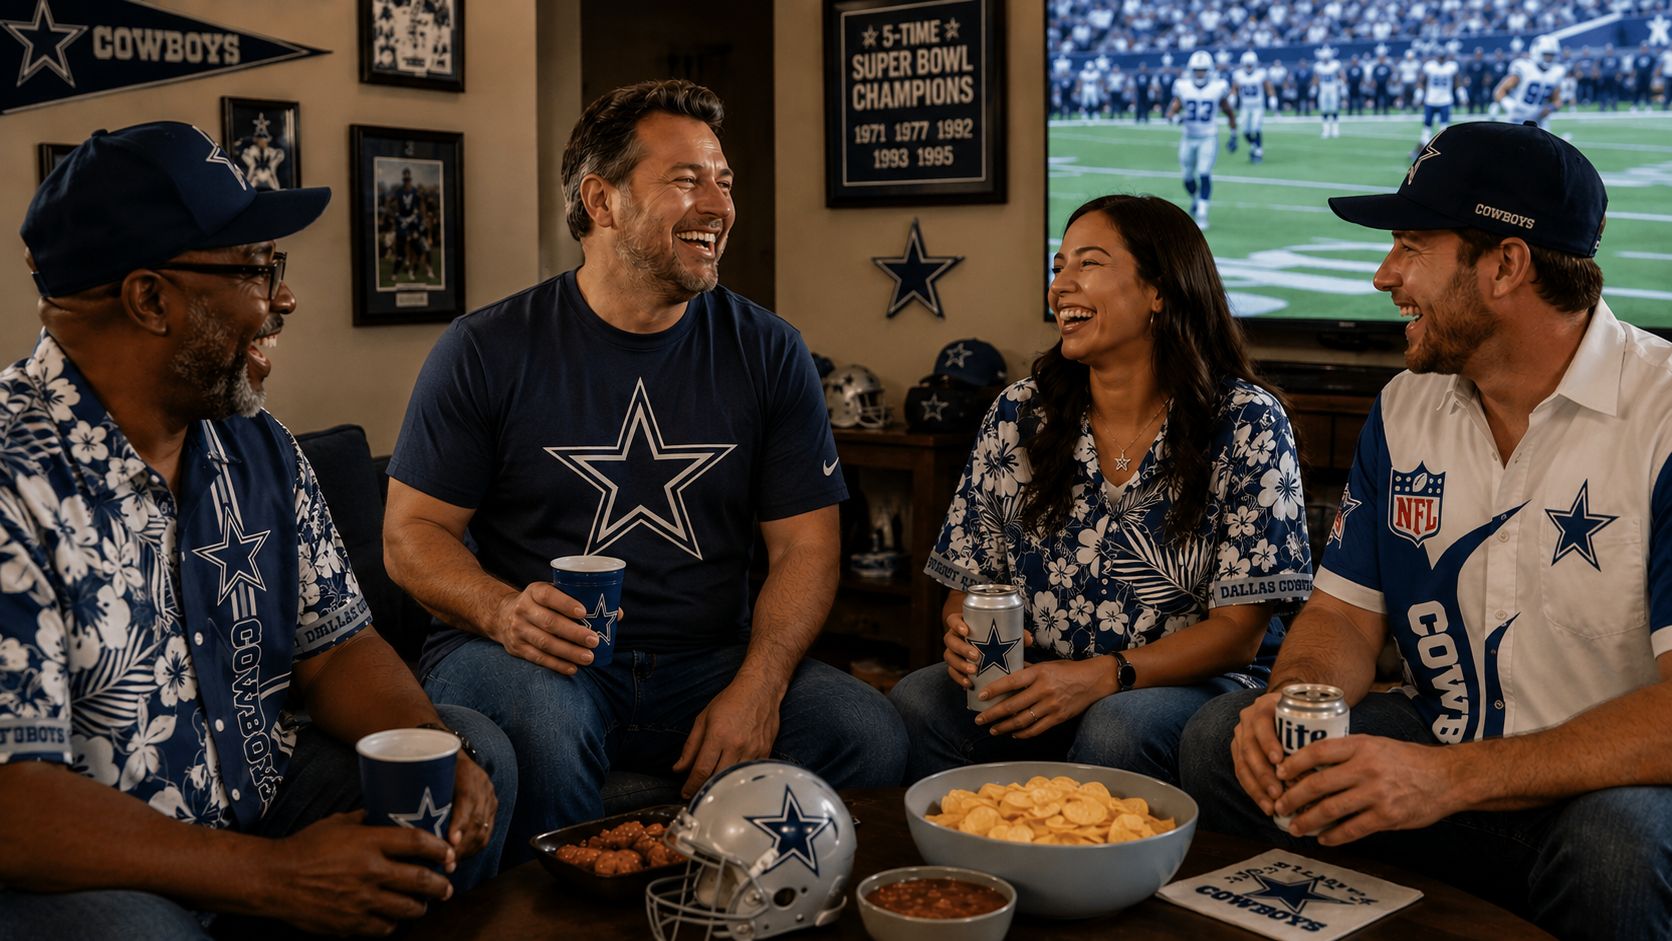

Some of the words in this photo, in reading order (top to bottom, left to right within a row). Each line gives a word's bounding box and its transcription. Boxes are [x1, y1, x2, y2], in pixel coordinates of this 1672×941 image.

[93, 25, 240, 64] COWBOYS
[882, 19, 941, 48] 5-TIME
[852, 49, 912, 80] SUPER
[916, 45, 974, 76] BOWL
[852, 75, 974, 112] CHAMPIONS
[854, 123, 886, 144] 1971
[894, 120, 930, 142] 1977
[937, 118, 974, 140] 1992
[873, 147, 909, 169] 1993
[916, 145, 954, 167] 1995
[1474, 203, 1536, 230] COWBOYS
[1395, 496, 1438, 536] NFL
[1221, 581, 1276, 599] DALLAS
[1195, 885, 1328, 932] COWBOYS
